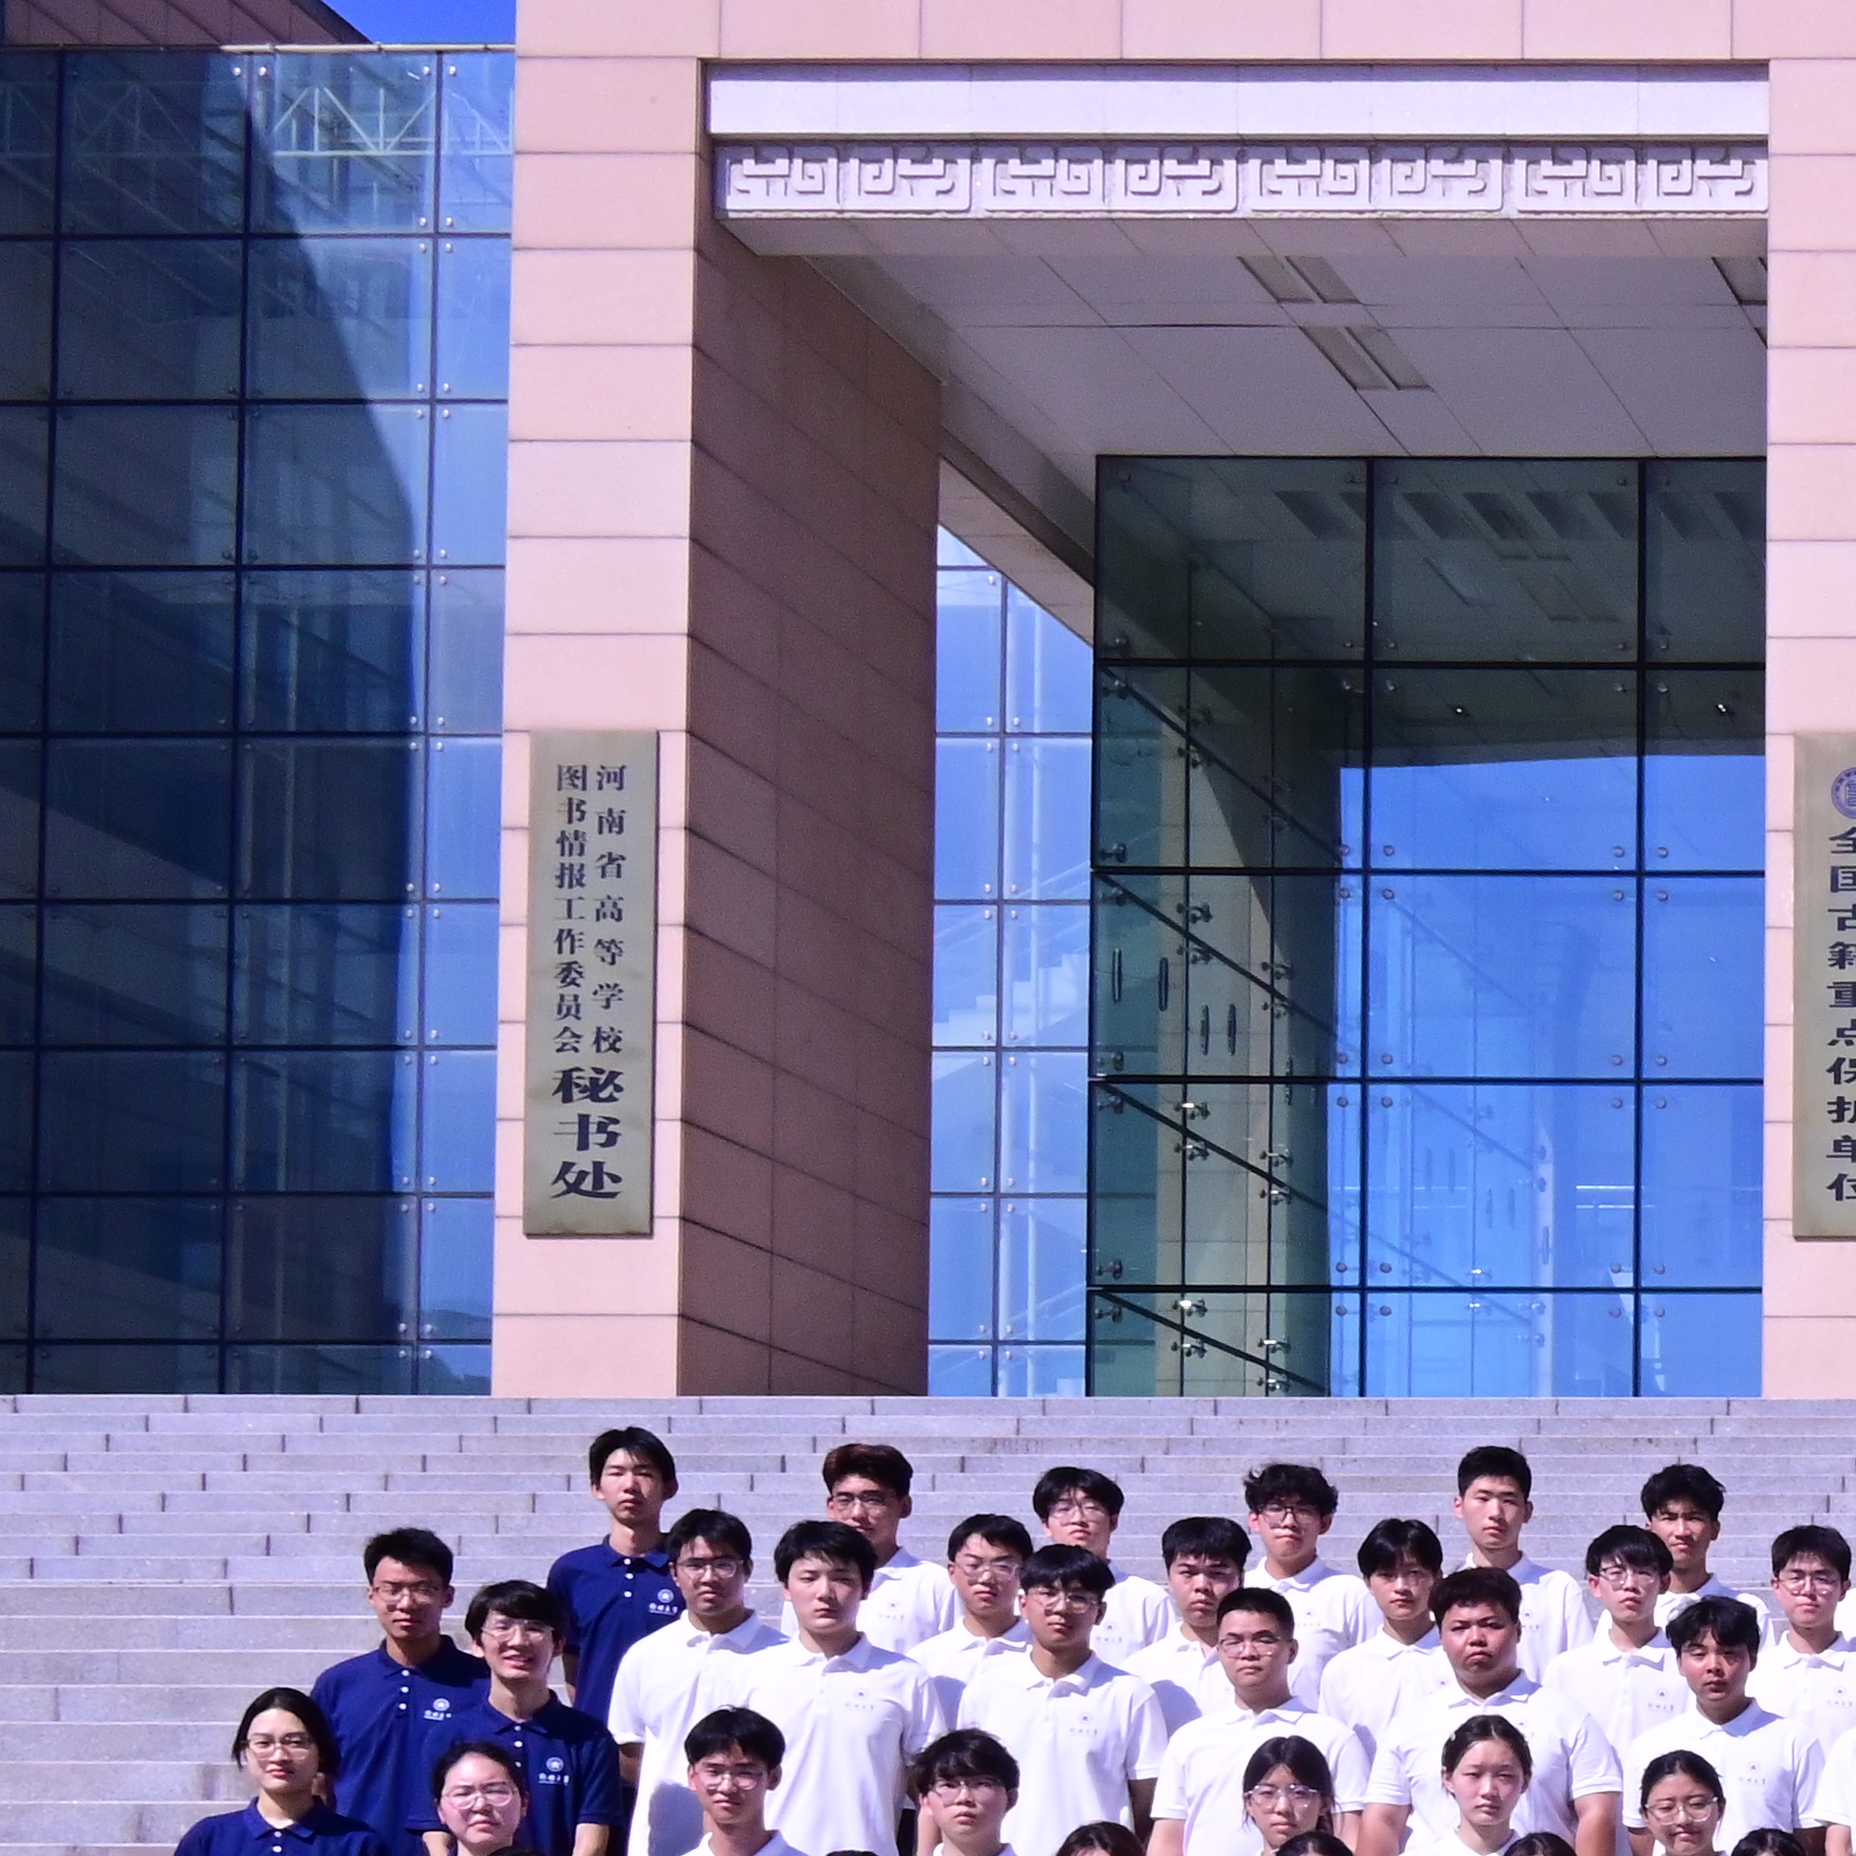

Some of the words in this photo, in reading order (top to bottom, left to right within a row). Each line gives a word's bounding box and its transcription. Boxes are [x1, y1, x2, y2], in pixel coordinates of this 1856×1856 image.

[553, 764, 588, 1054] 图书情报工作委员会
[591, 764, 627, 1055] 河南省高等学校
[550, 1066, 625, 1200] 秘书处
